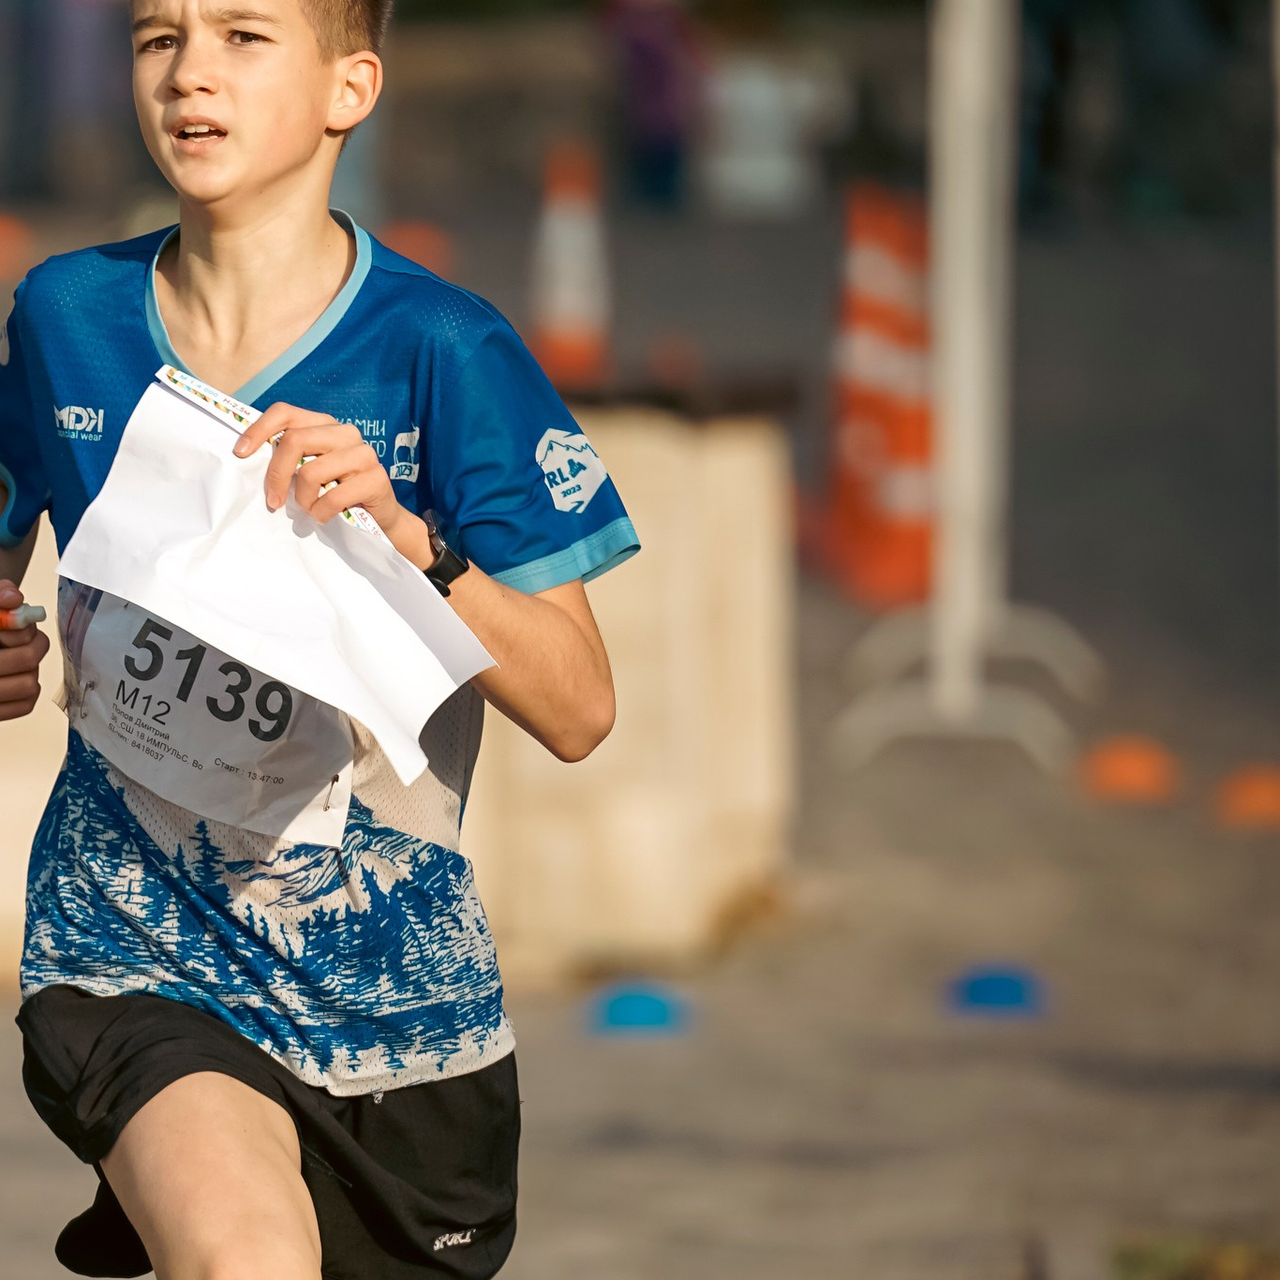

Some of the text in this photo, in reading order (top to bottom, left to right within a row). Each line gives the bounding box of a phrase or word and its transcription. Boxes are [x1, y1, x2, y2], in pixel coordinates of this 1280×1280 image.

[53, 404, 105, 433] MDK
[80, 432, 103, 442] wear
[561, 484, 582, 498] 2023
[123, 618, 293, 742] 5139
[116, 679, 171, 726] М12
[112, 703, 170, 741] Попов Дмитрий
[131, 740, 165, 762] 8418037
[136, 730, 145, 740] 18
[192, 759, 204, 770] Во
[214, 757, 239, 773] Старт
[247, 771, 285, 784] 13:47:00
